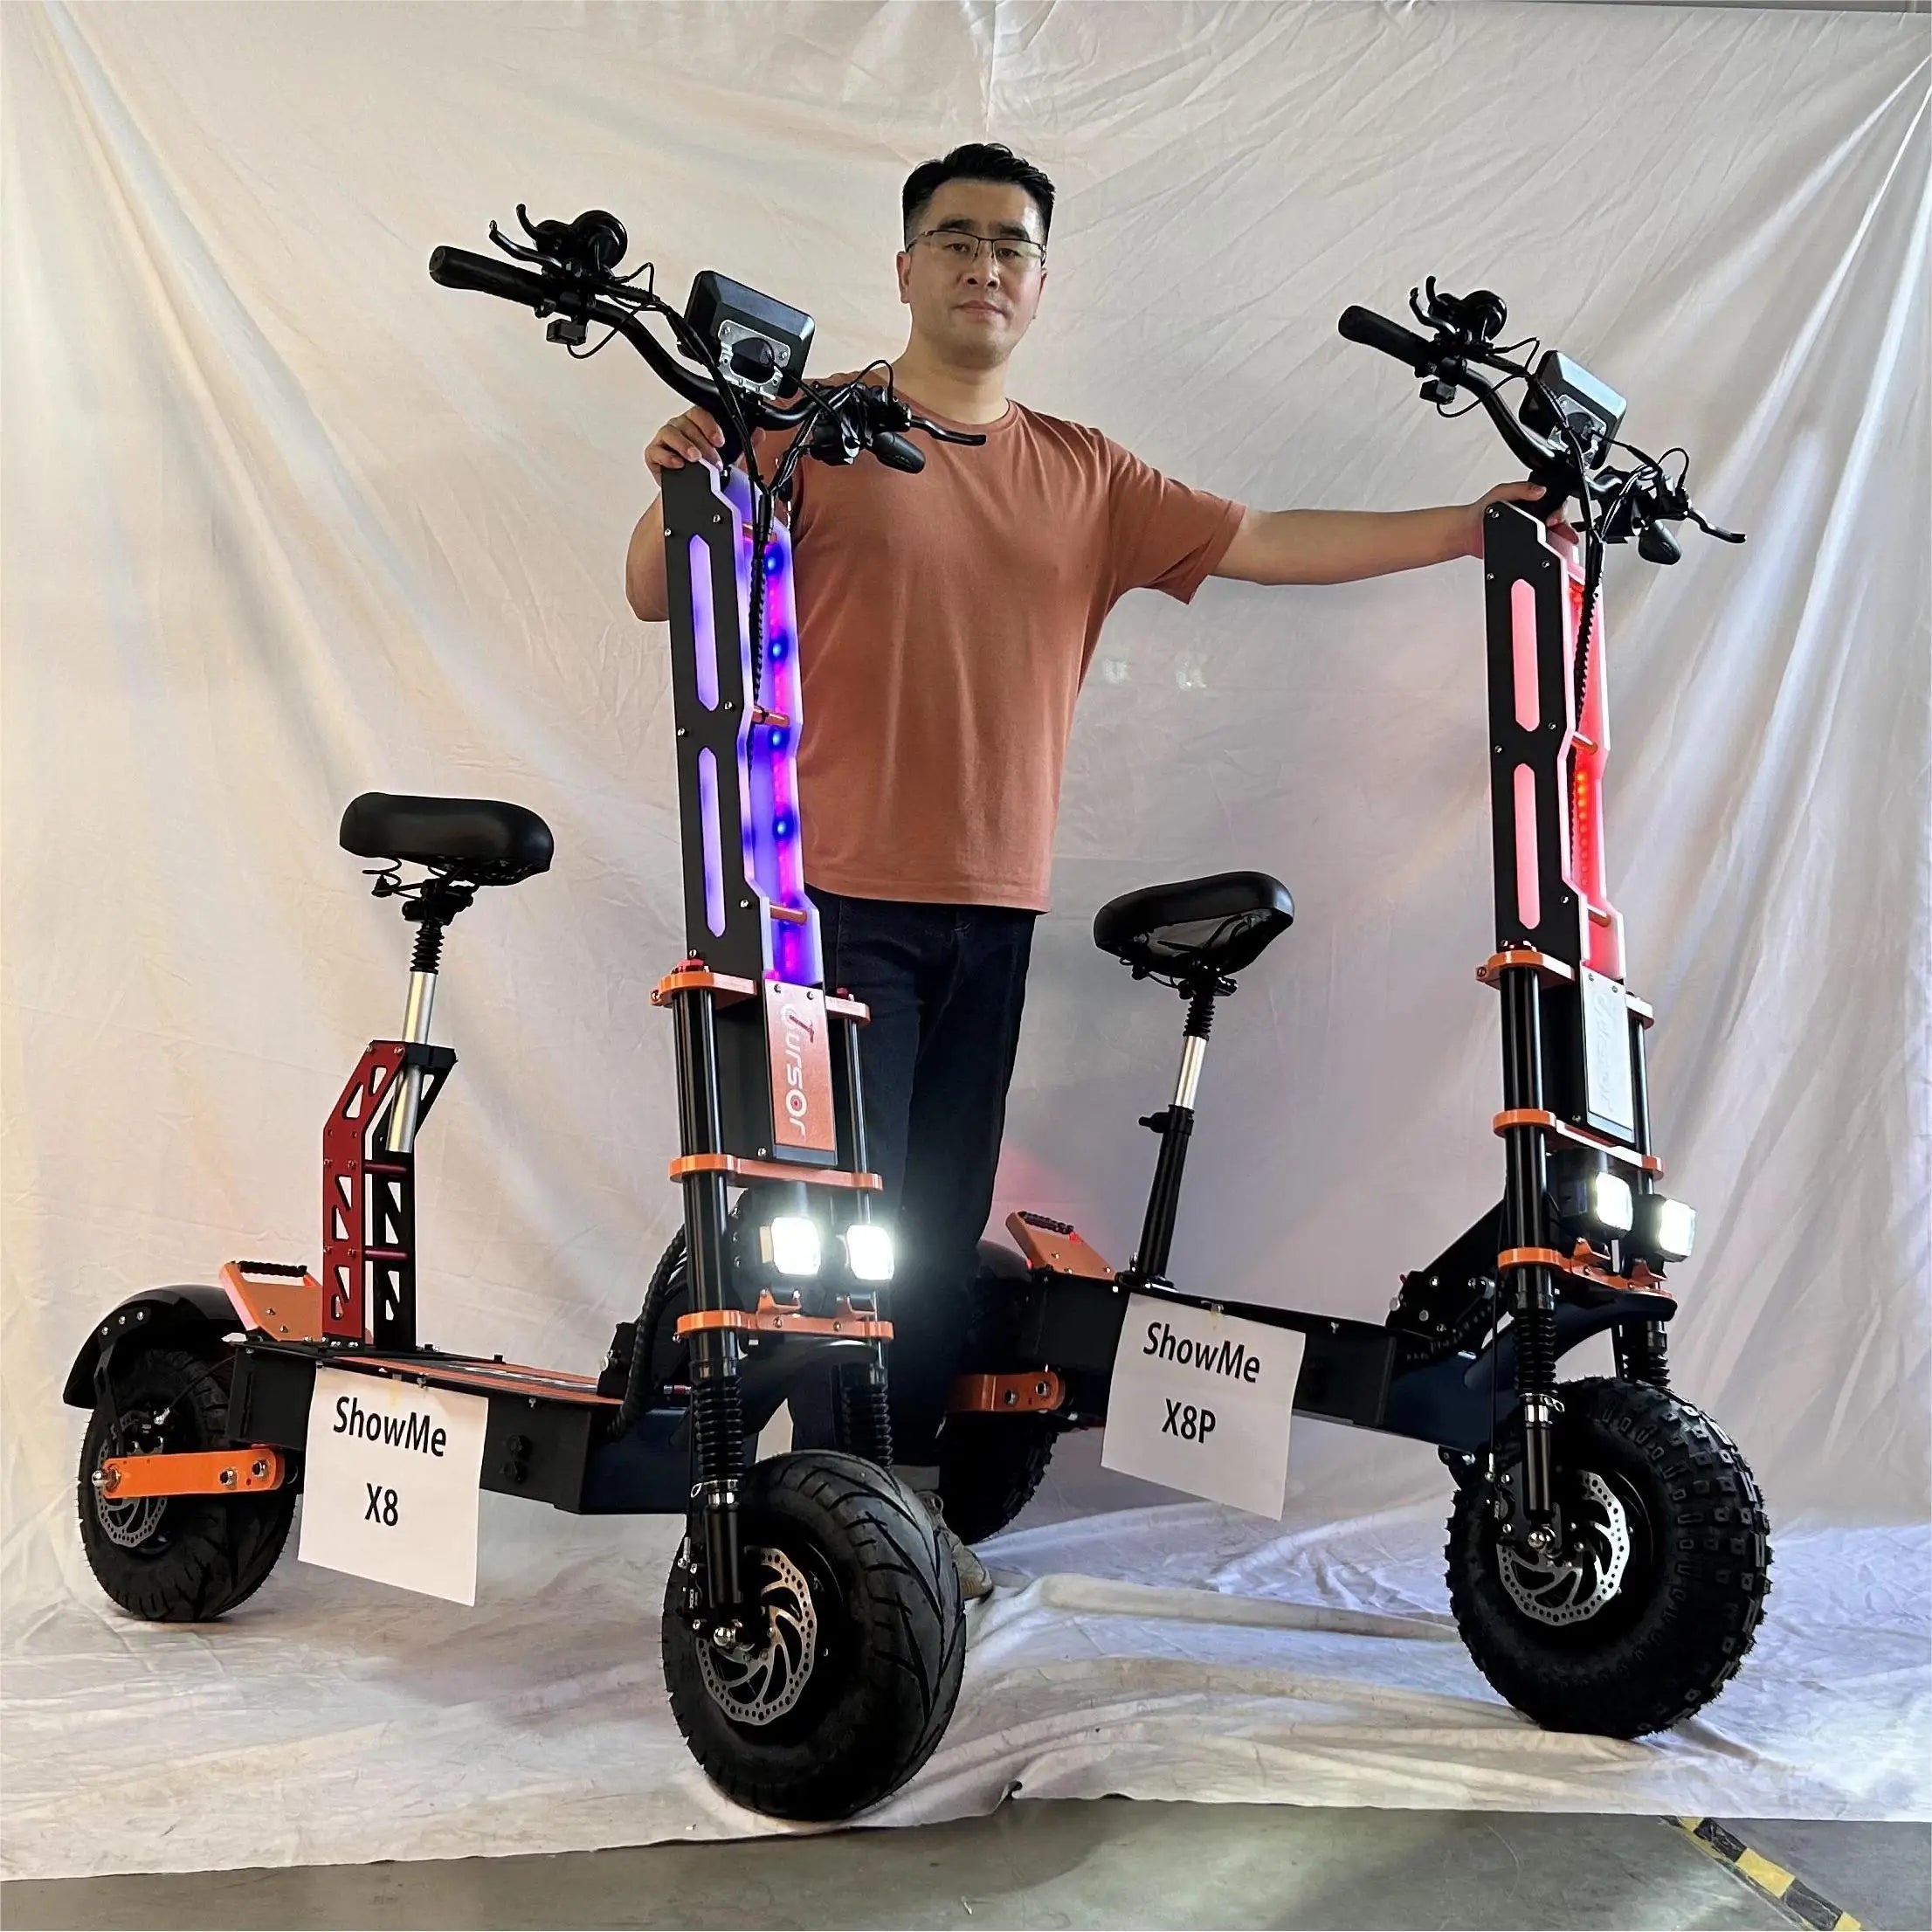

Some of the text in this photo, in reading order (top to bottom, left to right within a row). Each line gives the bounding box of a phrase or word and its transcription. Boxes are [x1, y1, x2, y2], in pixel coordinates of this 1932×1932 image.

[1143, 1321, 1260, 1383] ShowMe
[334, 1396, 447, 1457] ShowMe
[1162, 1398, 1216, 1443] X8P
[364, 1482, 399, 1527] X8
